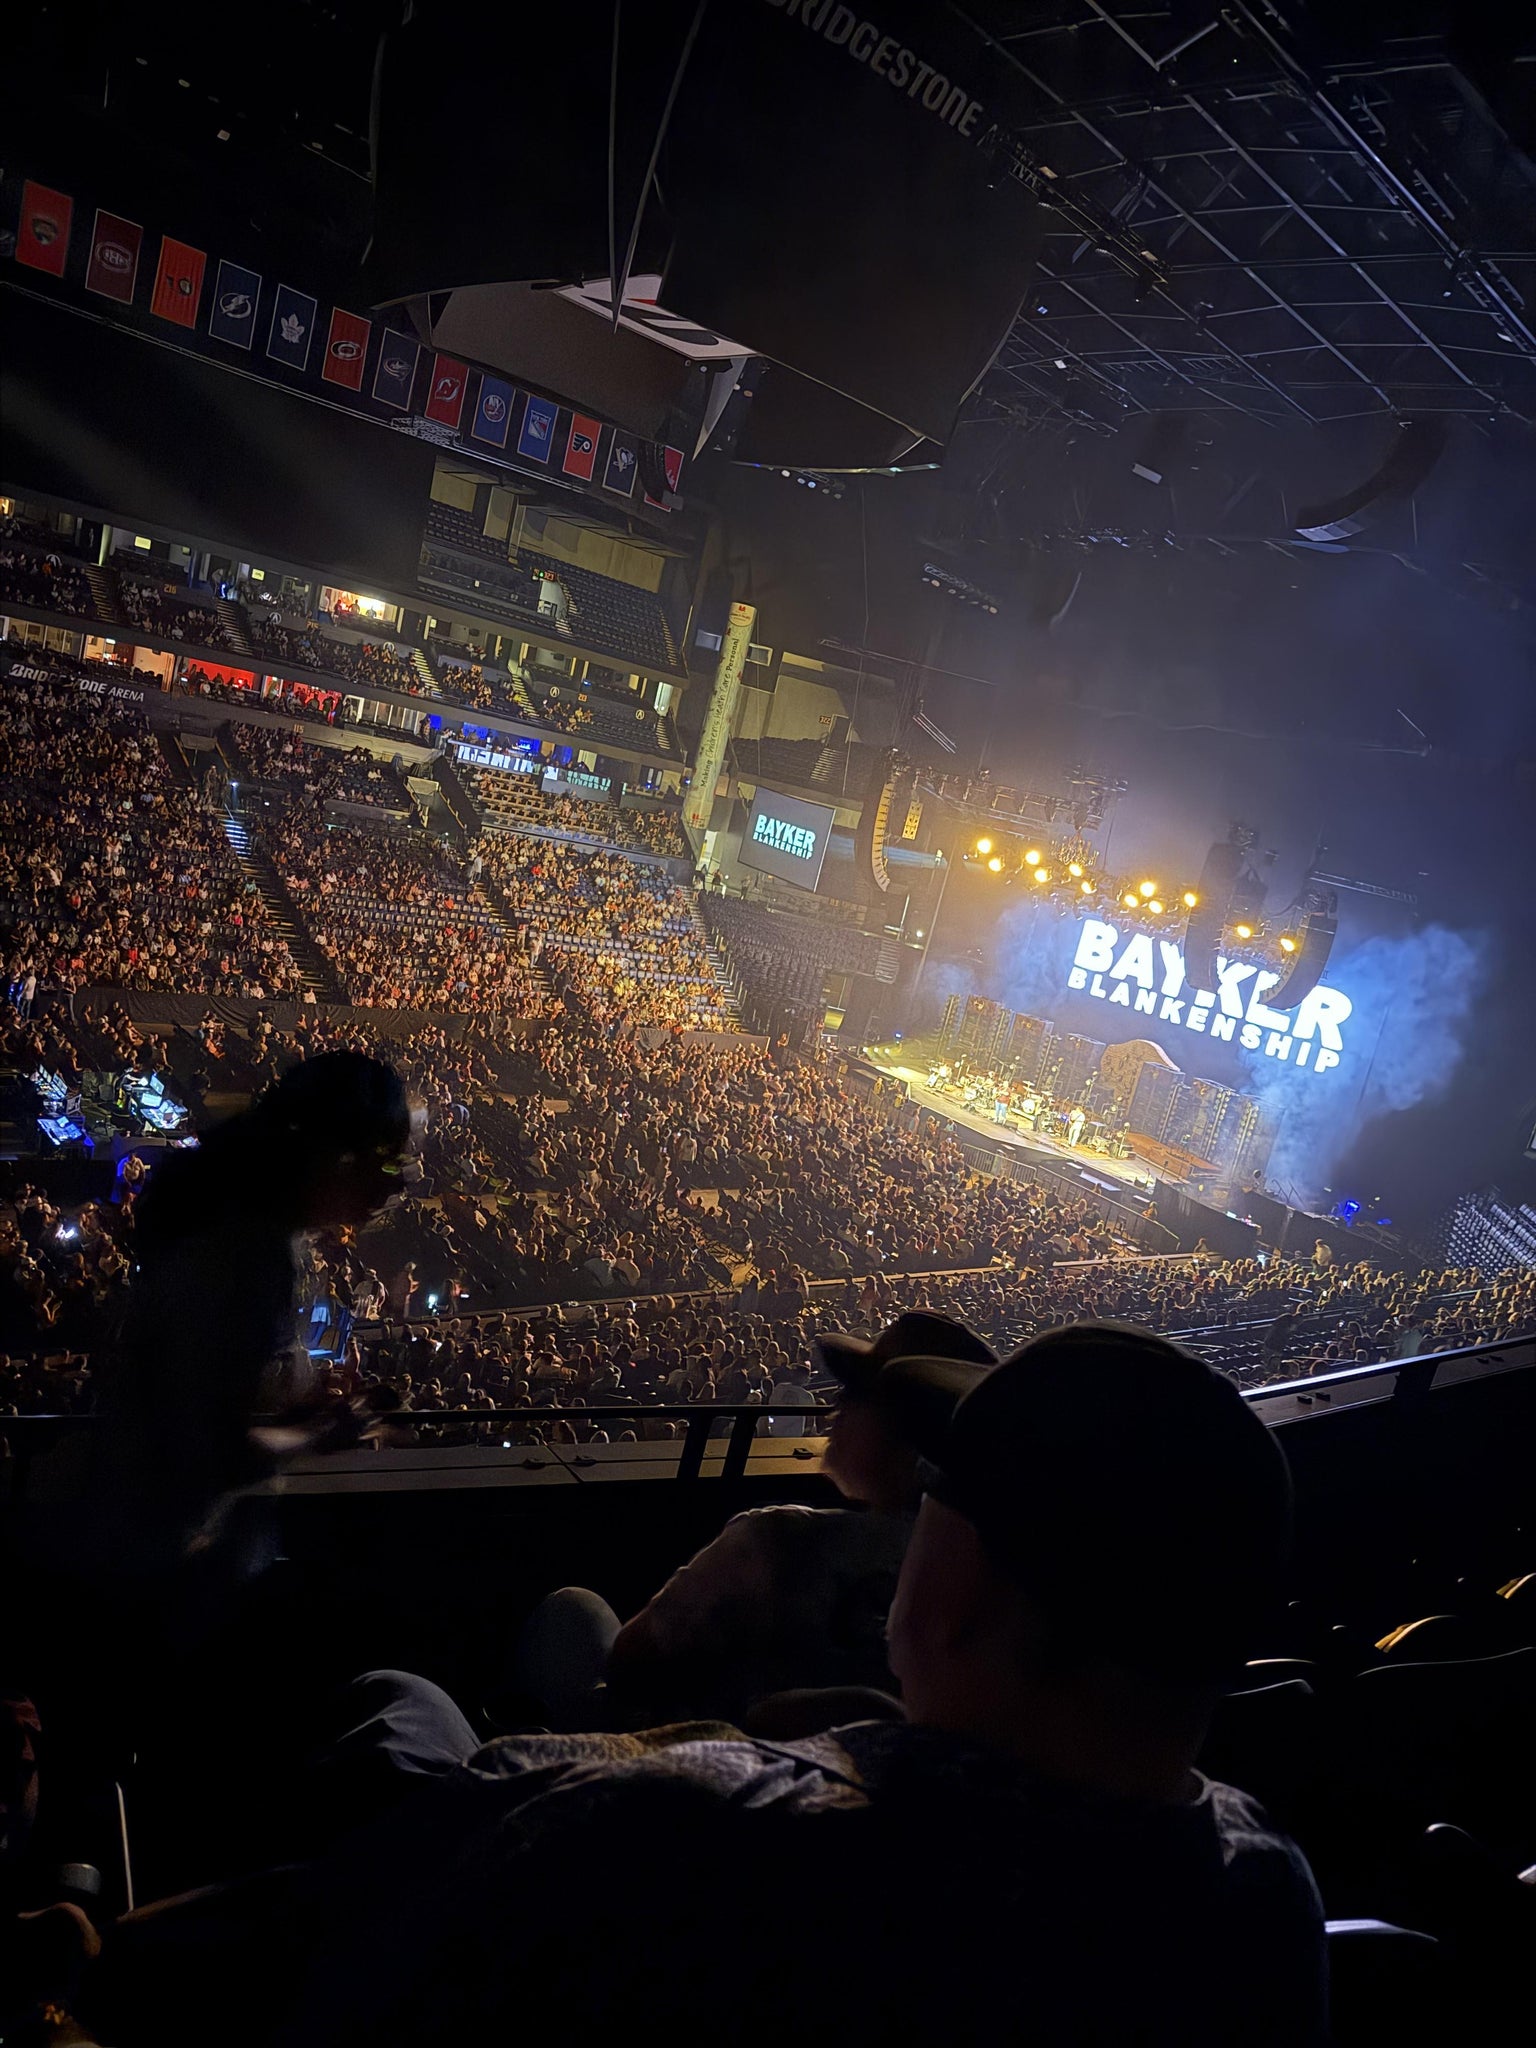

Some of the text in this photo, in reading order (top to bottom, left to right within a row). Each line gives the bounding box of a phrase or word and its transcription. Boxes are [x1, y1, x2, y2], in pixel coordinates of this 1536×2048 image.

[762, 0, 983, 138] RIDGESTONE
[107, 685, 146, 703] ARENA
[700, 759, 713, 787] Making
[725, 637, 740, 671] Personal
[752, 832, 812, 860] BLANKENSHIP
[754, 814, 816, 852] BAYKER
[1066, 966, 1341, 1074] BLANKENSHIP
[1073, 918, 1353, 1052] BAYKER
